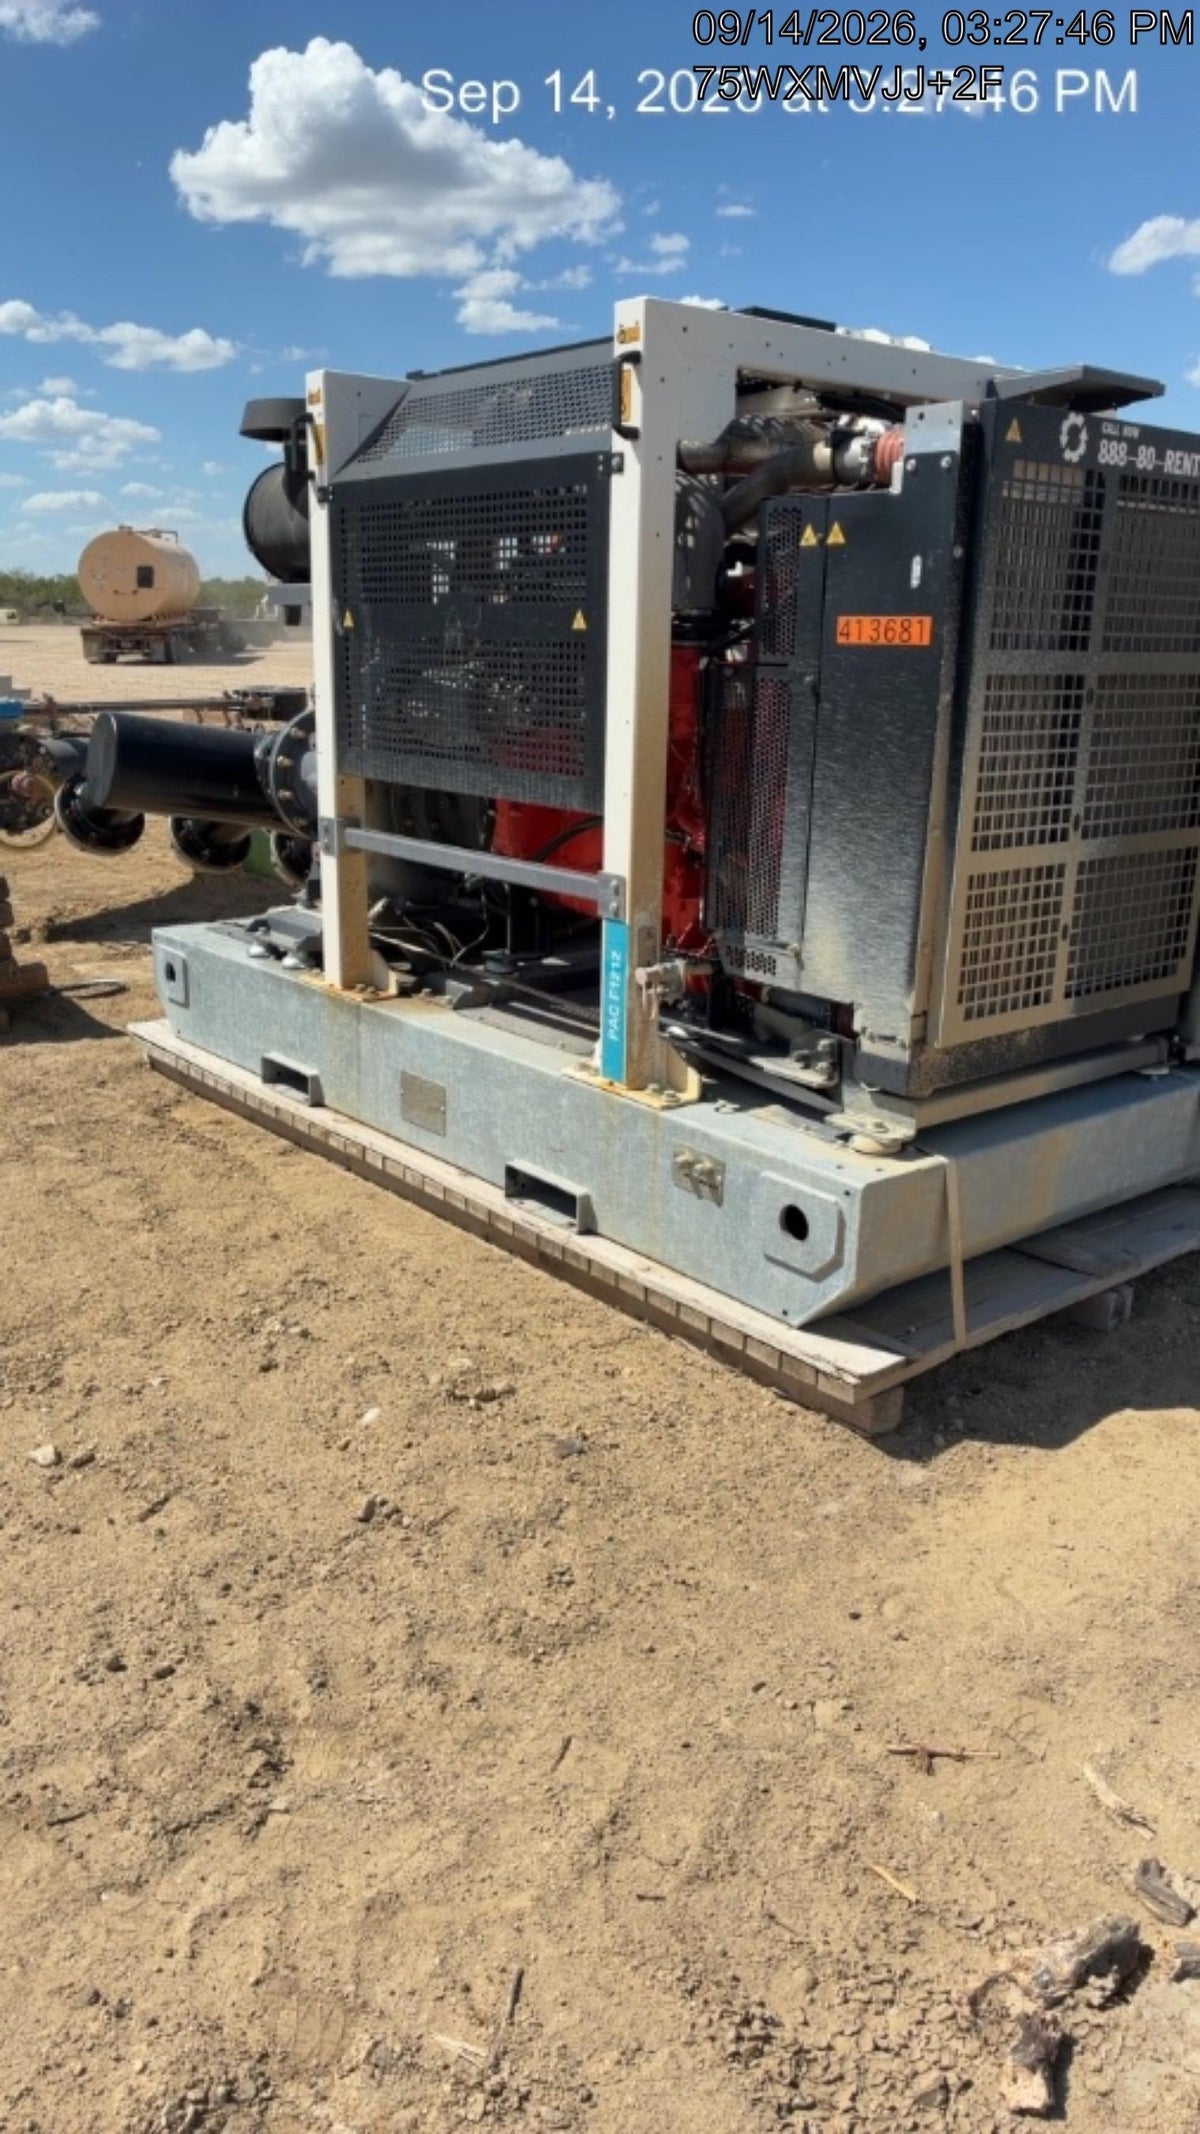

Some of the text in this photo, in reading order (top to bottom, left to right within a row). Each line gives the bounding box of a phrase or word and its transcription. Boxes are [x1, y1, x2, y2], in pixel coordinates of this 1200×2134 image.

[1097, 439, 1200, 478] 888-80-RENT
[838, 618, 924, 643] 413681
[608, 1005, 620, 1041] PAC
